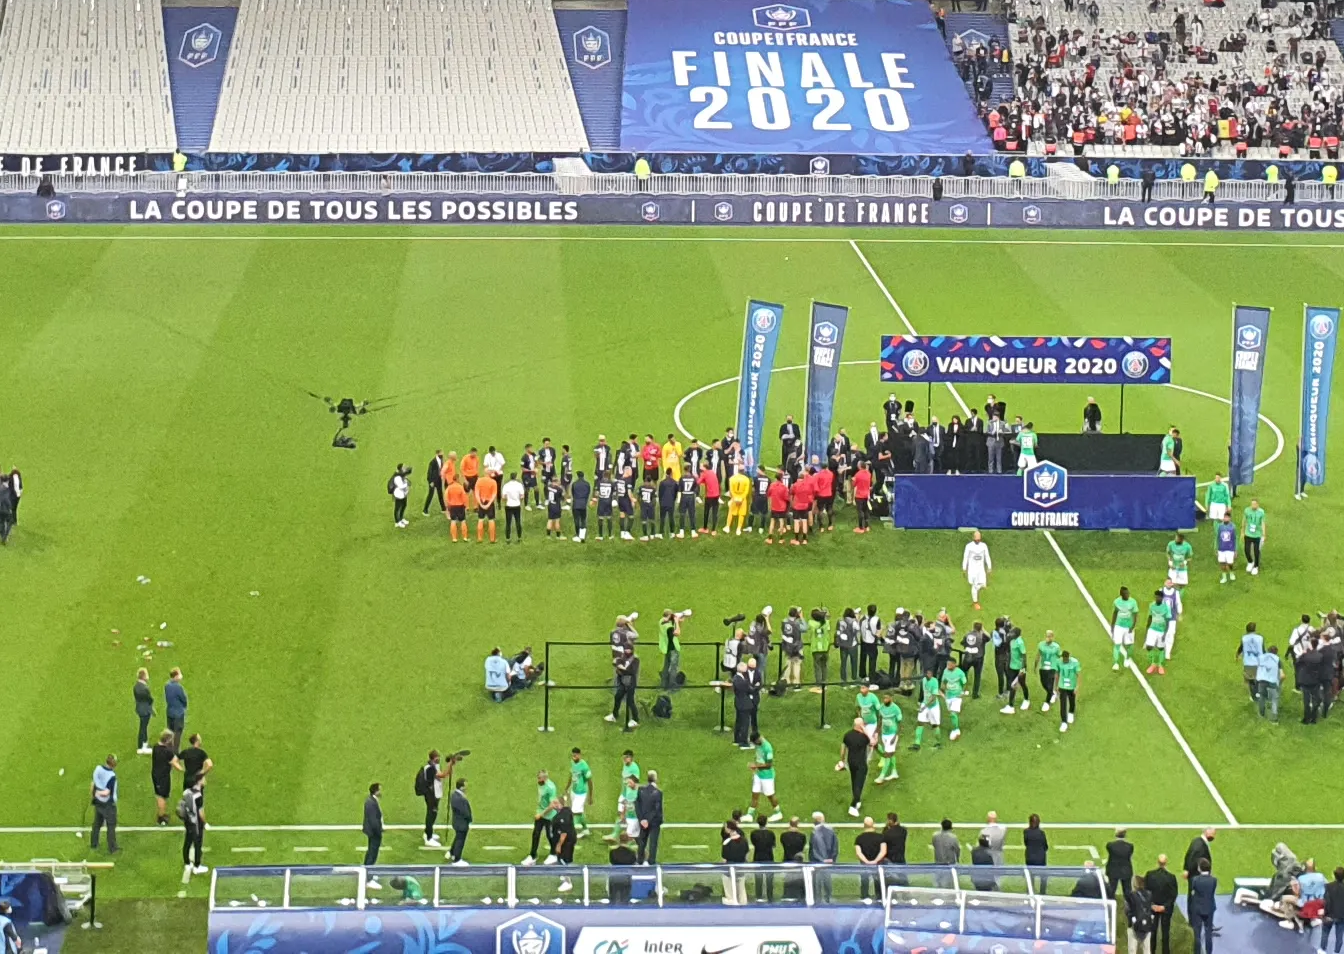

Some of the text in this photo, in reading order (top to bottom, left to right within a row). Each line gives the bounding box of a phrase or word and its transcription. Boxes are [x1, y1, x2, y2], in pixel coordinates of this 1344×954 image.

[714, 31, 859, 47] COUPE FRANCE
[672, 50, 916, 89] FINALE
[689, 86, 911, 133] 2020
[21, 156, 44, 177] DE
[60, 156, 137, 177] FRANCE
[129, 200, 578, 220] LA COUPE DE TOUS LES POSSIBLES
[753, 200, 929, 224] COUPE DE FRANCE
[1102, 206, 1135, 229] LA
[1143, 206, 1228, 229] COUPE
[1237, 206, 1271, 229] DE
[751, 334, 766, 369] 2020
[1312, 341, 1325, 375] 2020
[935, 356, 1118, 376] VAINQUEUR 2020
[1011, 511, 1080, 527] COUPE FRANCE
